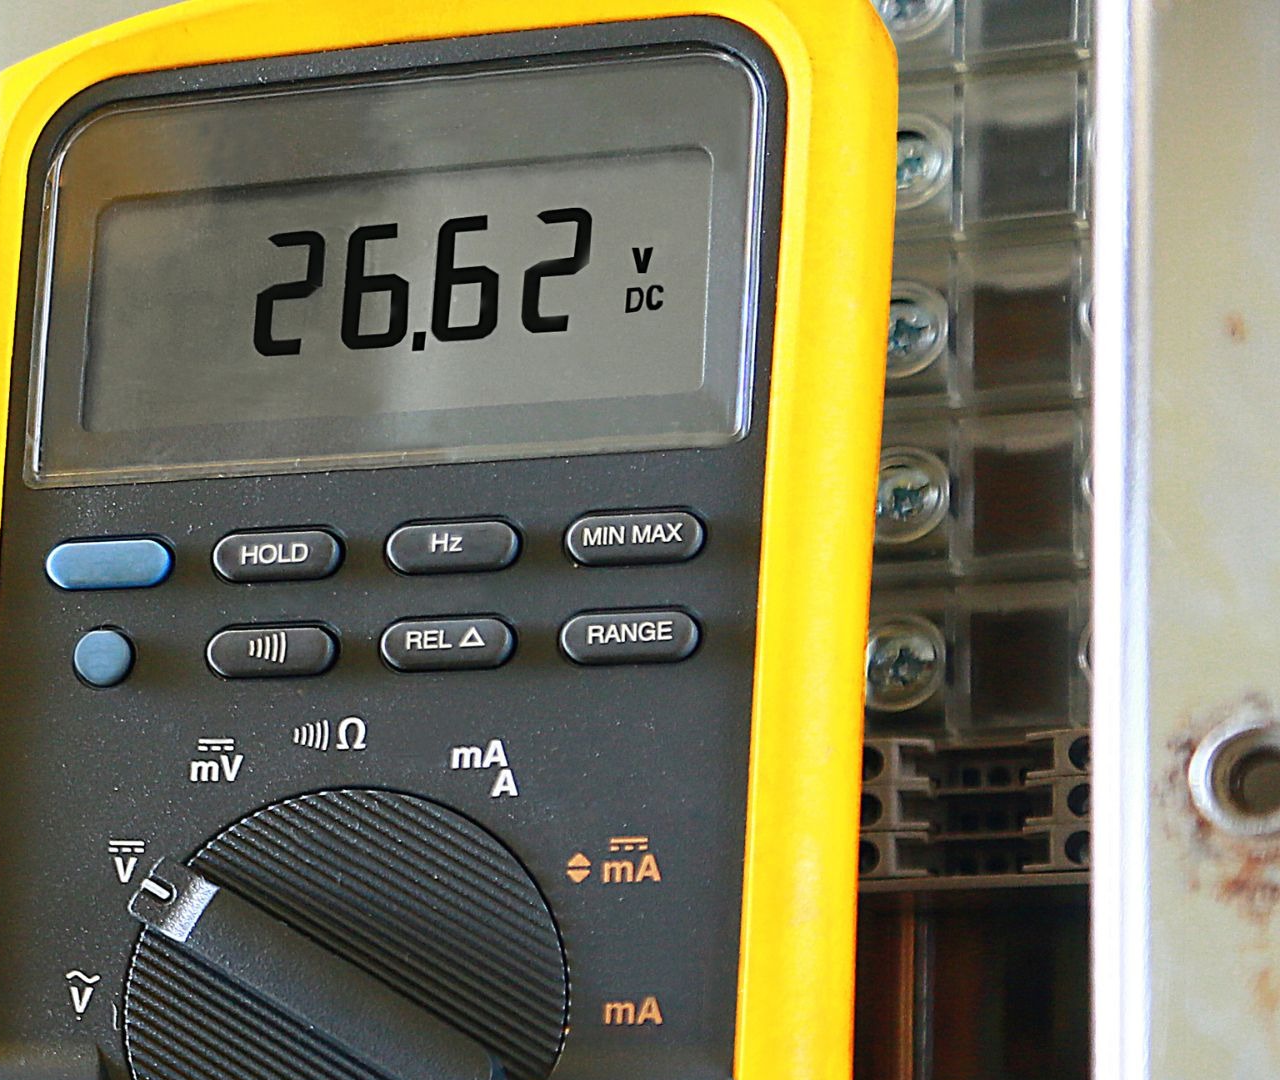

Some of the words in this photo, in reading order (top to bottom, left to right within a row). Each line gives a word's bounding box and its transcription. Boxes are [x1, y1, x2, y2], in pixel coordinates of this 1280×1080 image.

[253, 207, 593, 357] 26.62
[631, 246, 654, 274] V
[624, 284, 664, 314] DC
[431, 532, 463, 553] Hz
[583, 525, 625, 546] MIN
[632, 522, 682, 544] MAX
[241, 543, 309, 565] HOLD
[406, 629, 453, 650] REL
[587, 620, 673, 644] RANGE
[451, 739, 508, 769] mA
[190, 754, 244, 782] mV
[491, 769, 518, 797] A
[114, 856, 138, 883] V
[603, 857, 661, 883] mA
[69, 985, 94, 1013] V
[604, 997, 663, 1025] mA
